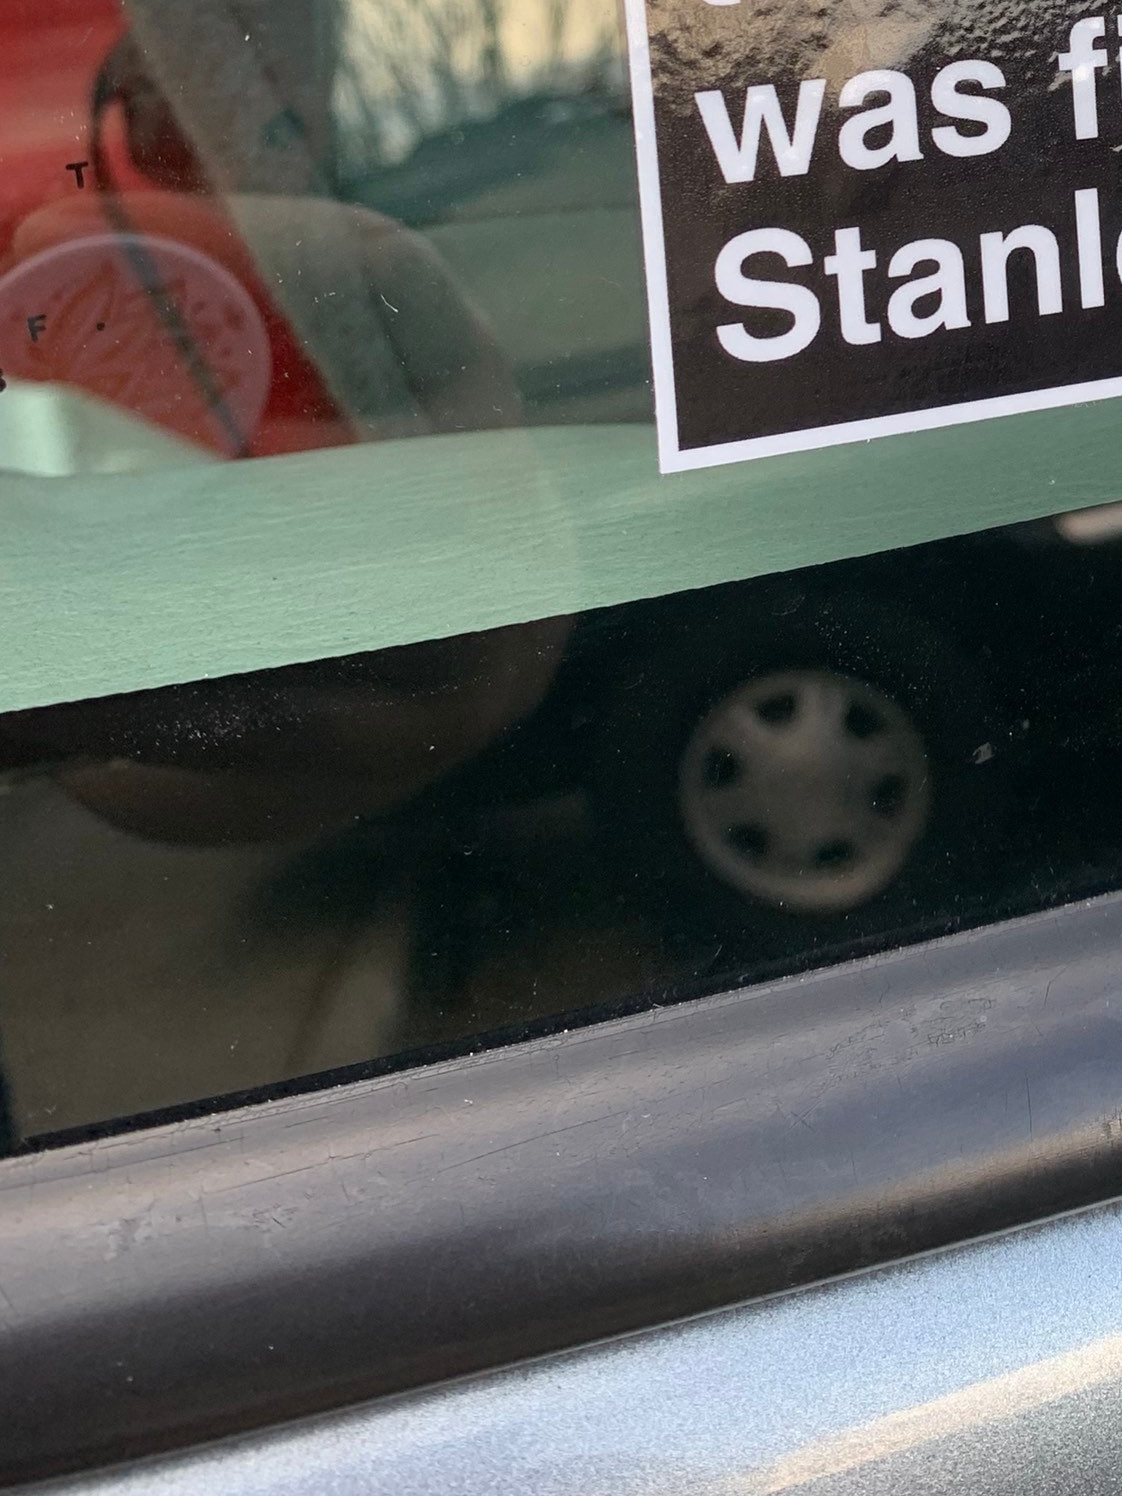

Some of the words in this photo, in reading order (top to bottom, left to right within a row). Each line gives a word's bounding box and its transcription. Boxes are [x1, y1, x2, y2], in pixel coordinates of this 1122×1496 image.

[693, 58, 1012, 184] was
[65, 160, 89, 189] T
[27, 313, 47, 342] F
